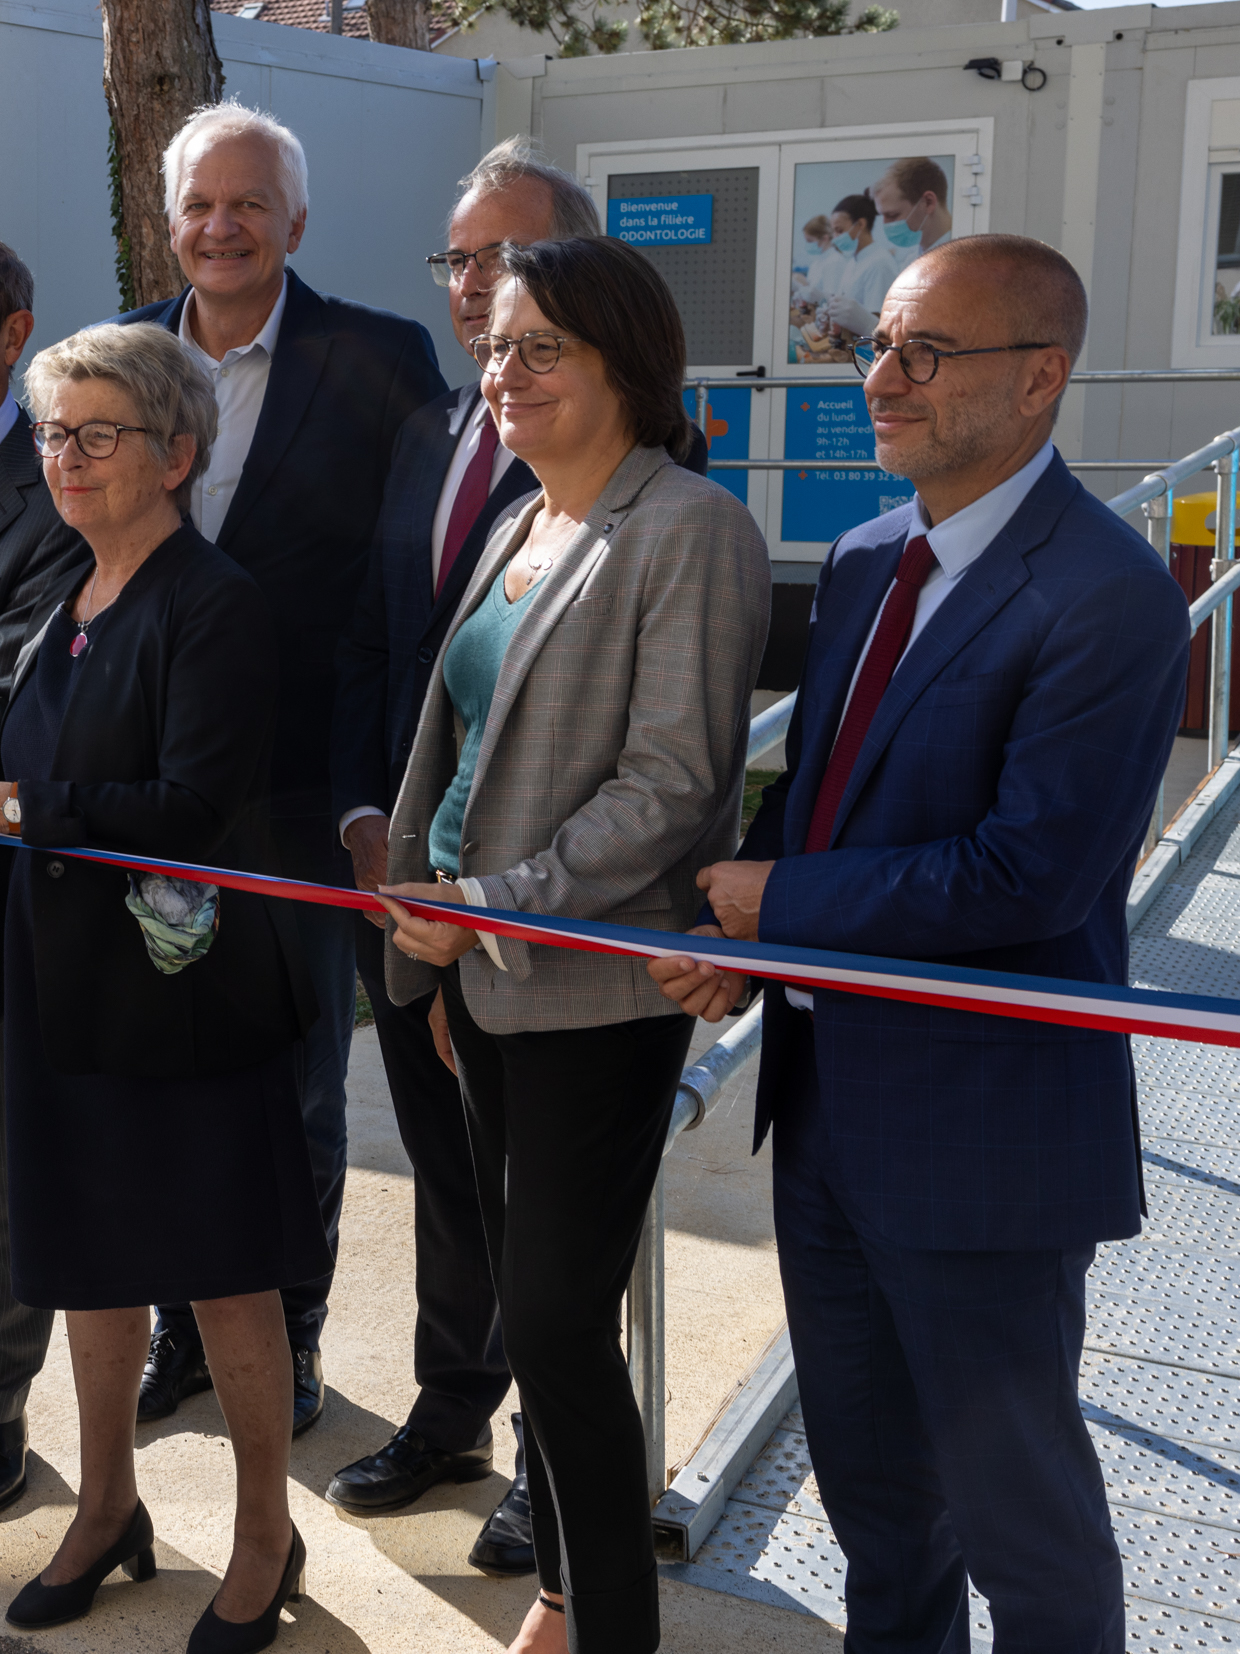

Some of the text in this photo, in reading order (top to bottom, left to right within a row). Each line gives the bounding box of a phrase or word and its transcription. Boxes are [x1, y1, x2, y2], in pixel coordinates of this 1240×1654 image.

[620, 202, 678, 213] Bienvenue
[620, 214, 694, 227] dans la filière
[619, 228, 706, 242] ODONTOLOGIE
[817, 400, 853, 409] Accueil
[817, 413, 856, 421] du lundi
[816, 438, 850, 446] 9h-12h
[829, 450, 868, 458] 14h-17h
[815, 471, 831, 480] Tél.
[833, 472, 846, 481] 03
[848, 472, 861, 481] 80
[863, 472, 876, 481] 39
[878, 471, 890, 481] 32
